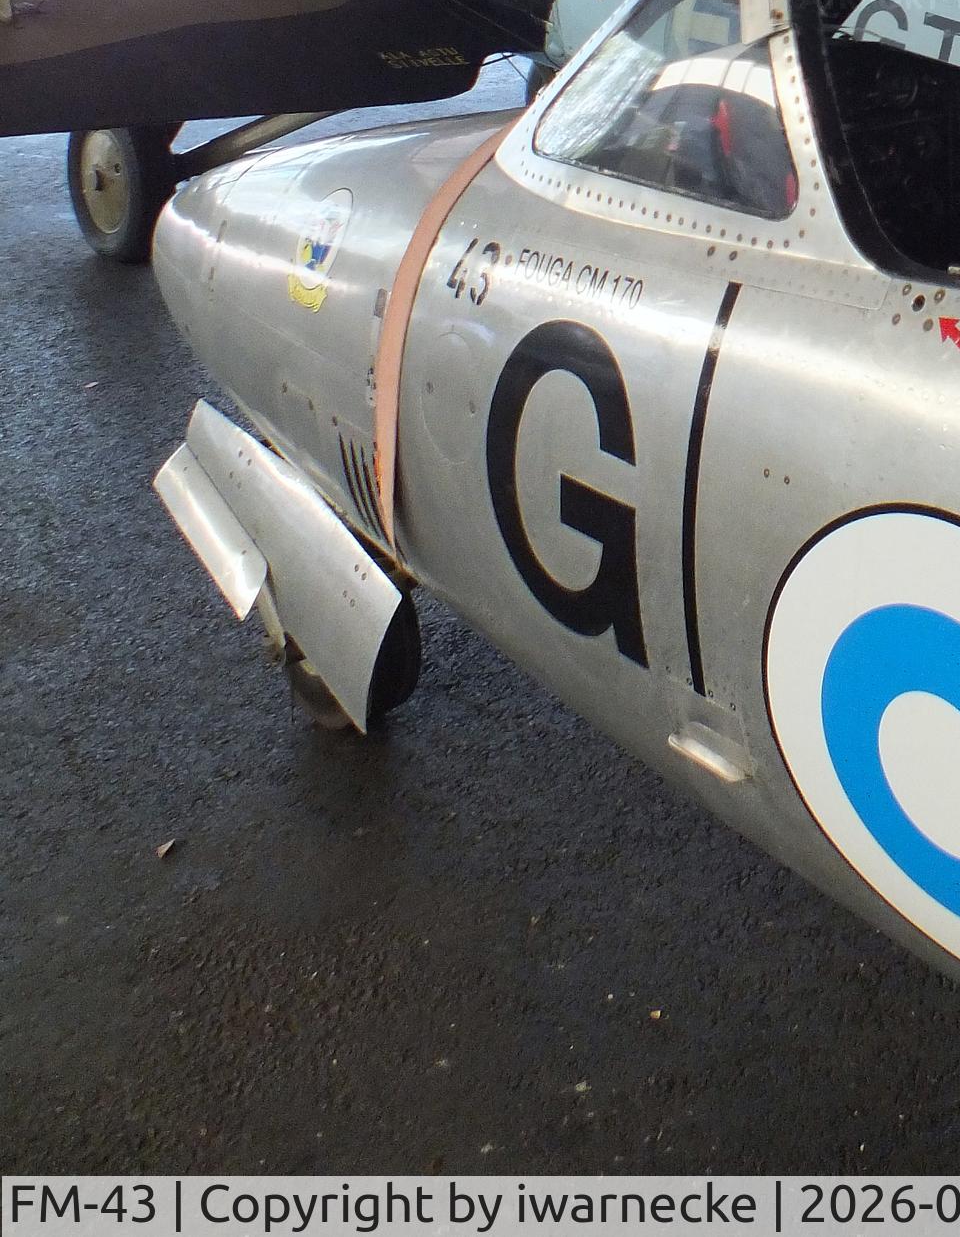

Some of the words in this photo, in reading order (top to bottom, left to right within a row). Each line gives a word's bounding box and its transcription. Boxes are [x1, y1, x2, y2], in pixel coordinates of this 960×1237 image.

[446, 237, 501, 306] 43
[514, 247, 574, 292] FOUGA
[575, 264, 611, 298] CM
[611, 273, 644, 310] 170
[487, 319, 649, 669] G
